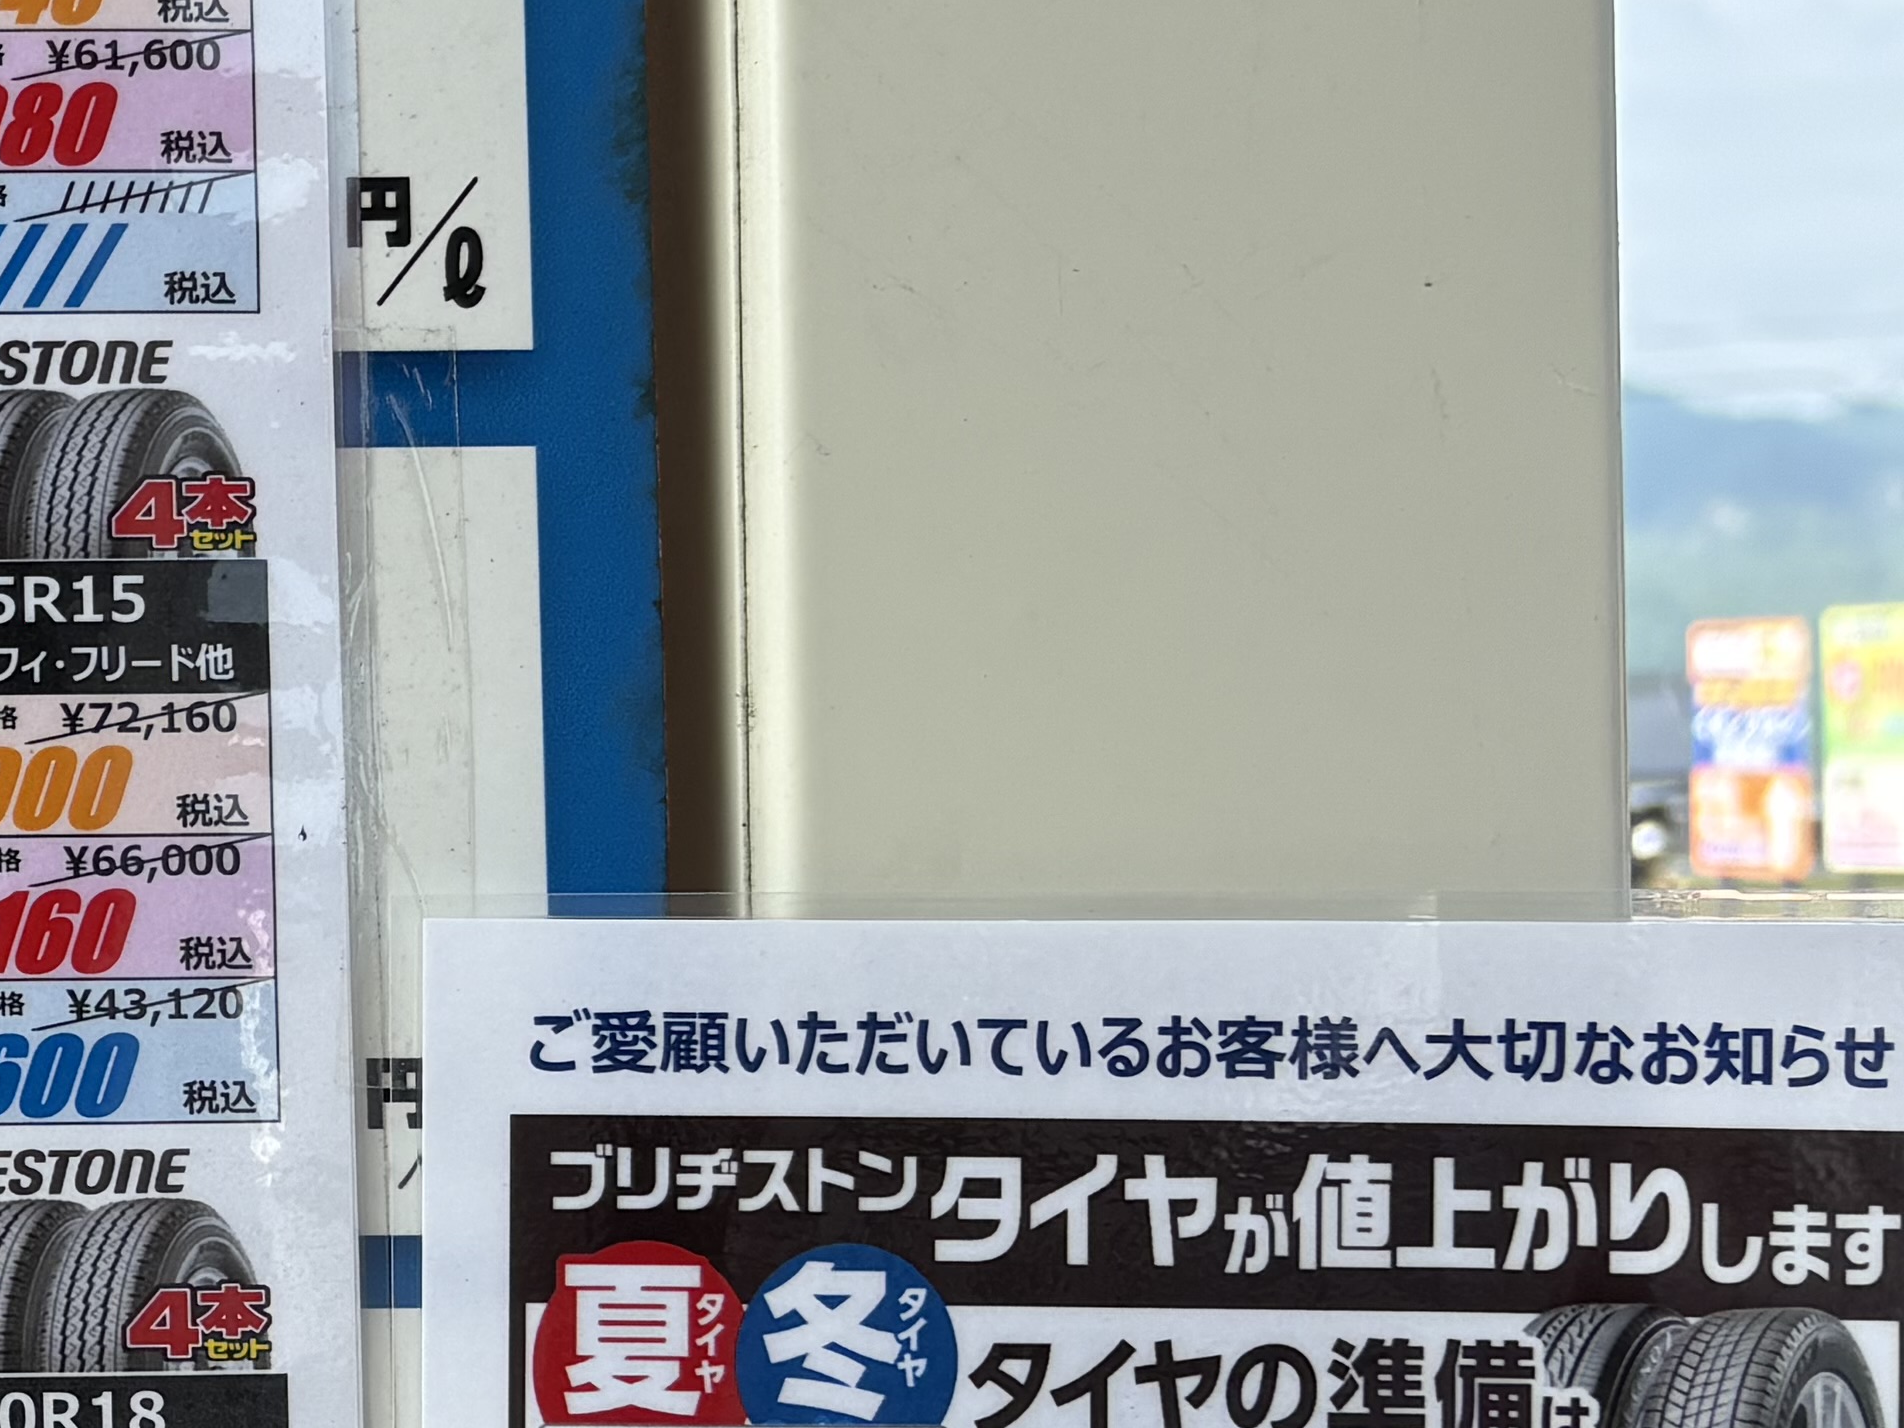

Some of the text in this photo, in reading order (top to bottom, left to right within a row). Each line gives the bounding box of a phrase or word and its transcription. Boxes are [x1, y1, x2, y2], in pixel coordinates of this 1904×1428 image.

[528, 1009, 1896, 1089] ご愛顧いただいているお客様へ大切なお知らせ
[564, 1264, 704, 1418] 夏
[694, 1291, 727, 1395] タイヤ
[763, 1262, 889, 1422] 冬
[896, 1285, 927, 1389] タイヤ
